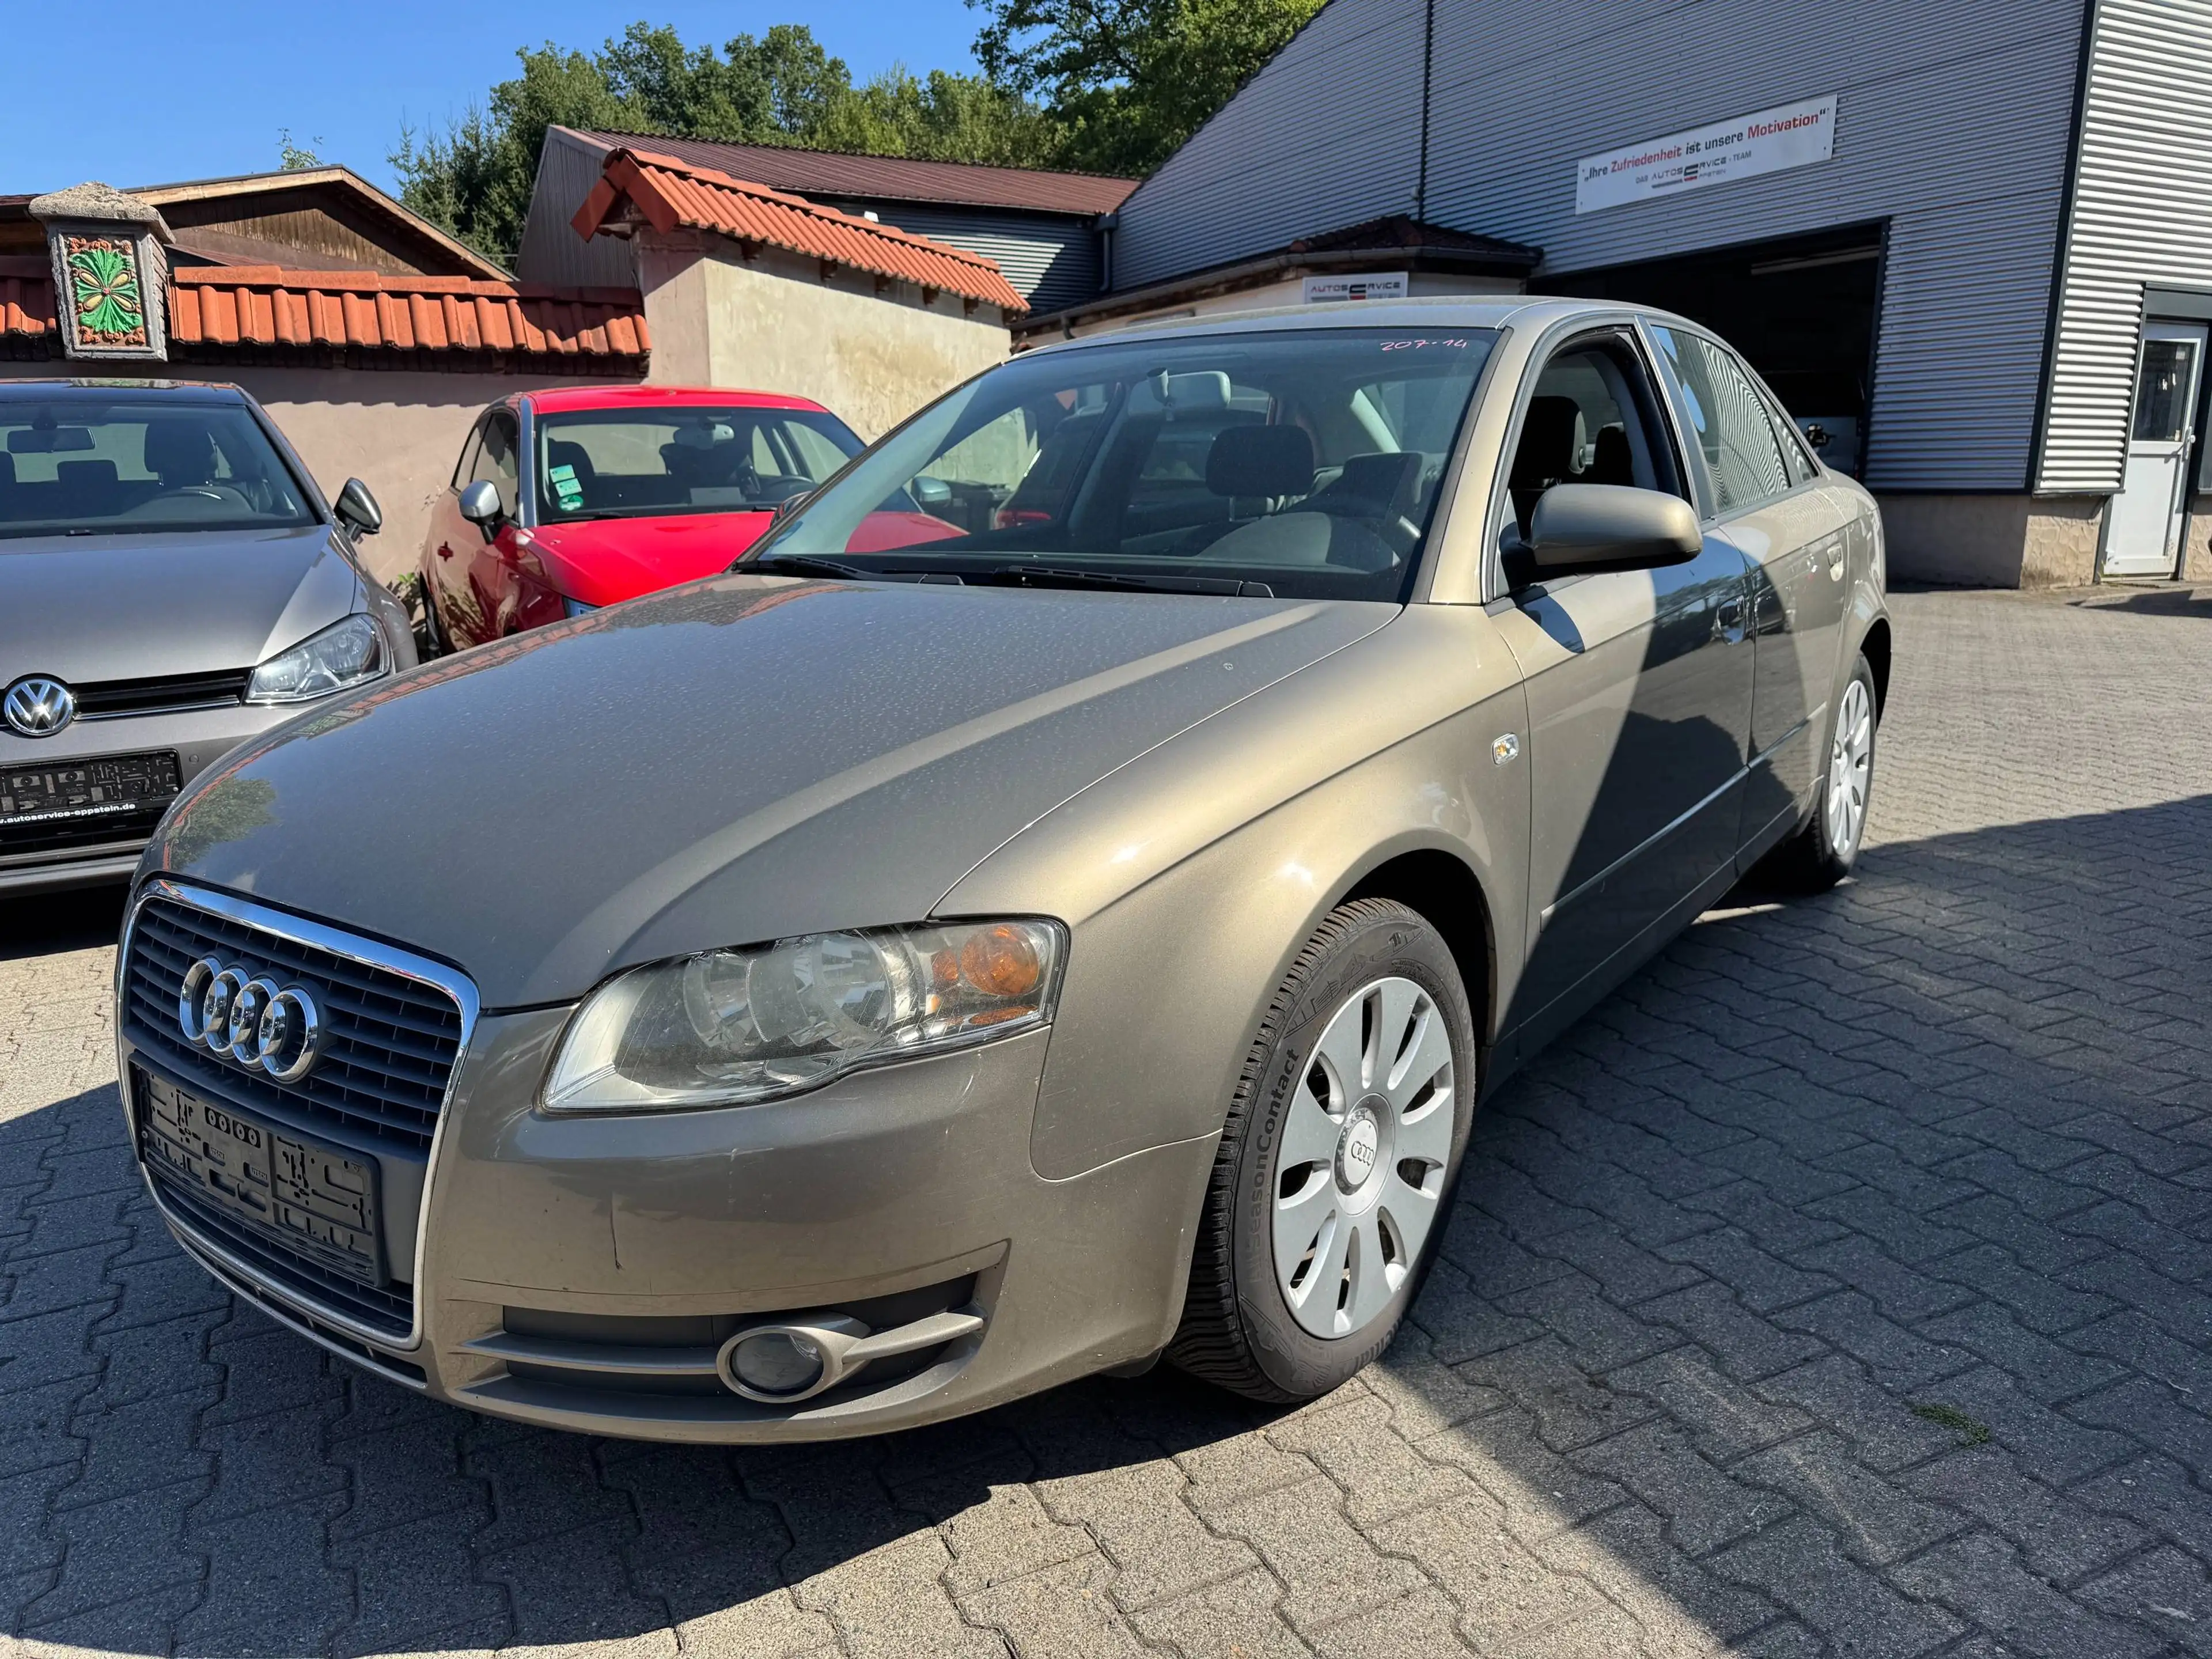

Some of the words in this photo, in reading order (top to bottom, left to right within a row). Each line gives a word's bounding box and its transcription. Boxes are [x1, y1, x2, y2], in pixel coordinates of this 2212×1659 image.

[1611, 146, 1683, 173] Zufriedenheit
[1685, 142, 1702, 155] ist
[1705, 132, 1744, 150] unsere
[1733, 150, 1752, 162] TEAM
